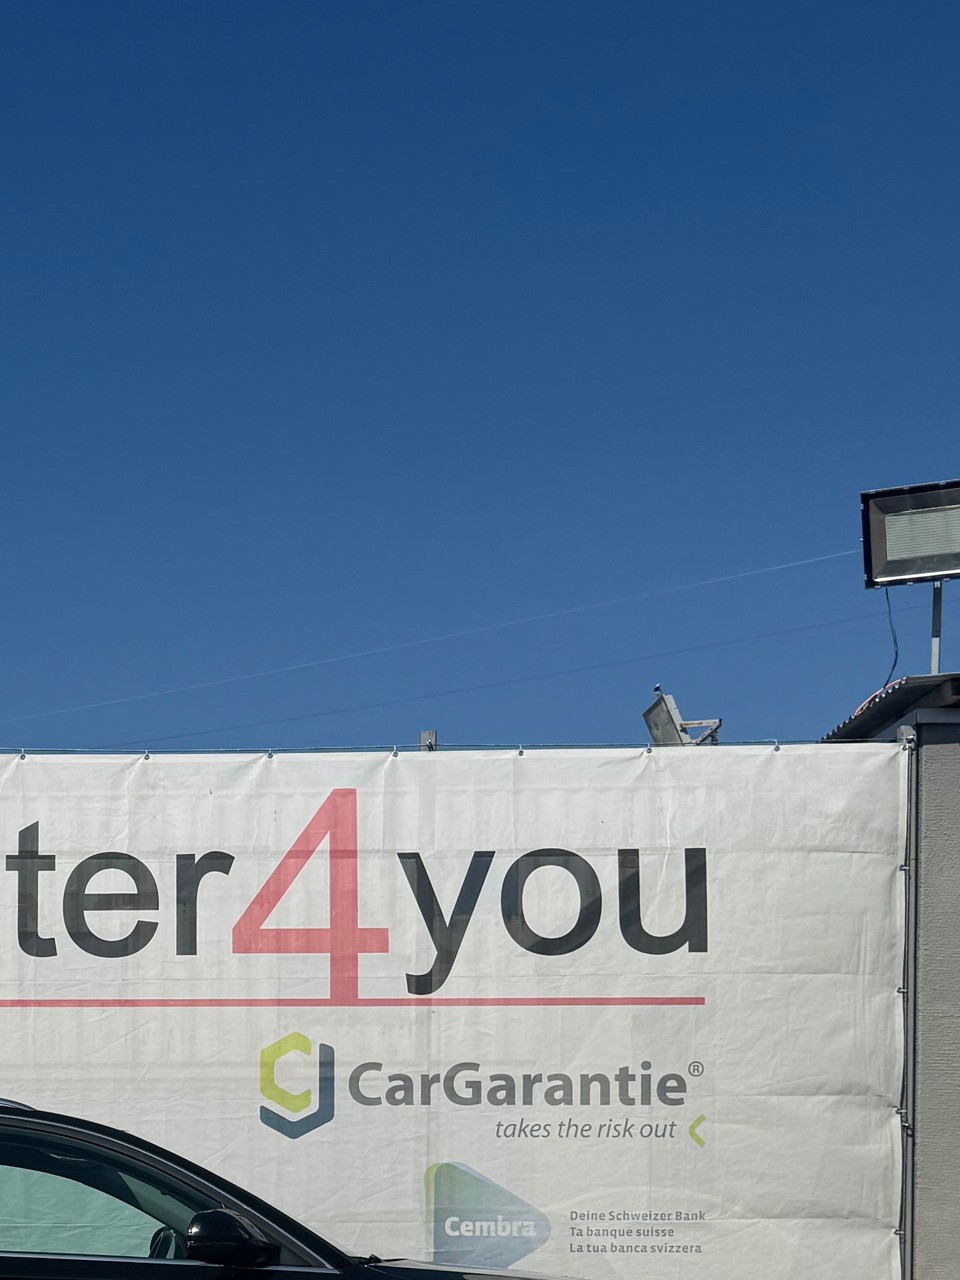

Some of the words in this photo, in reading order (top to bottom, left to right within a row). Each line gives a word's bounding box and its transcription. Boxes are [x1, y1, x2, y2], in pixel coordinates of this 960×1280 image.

[495, 1117, 552, 1139] takes
[557, 1117, 593, 1139] the
[598, 1117, 634, 1139] risk
[640, 1120, 677, 1139] out
[569, 1210, 606, 1222] Deine
[608, 1210, 672, 1222] Schweizer
[675, 1210, 706, 1222] Bank
[444, 1215, 537, 1237] Cembra
[569, 1226, 584, 1237] Ta
[586, 1226, 633, 1240] banque
[636, 1226, 675, 1238] suisse
[569, 1242, 585, 1254] La
[586, 1243, 608, 1254] tua
[610, 1242, 648, 1254] banca
[650, 1242, 703, 1254] svizzera
